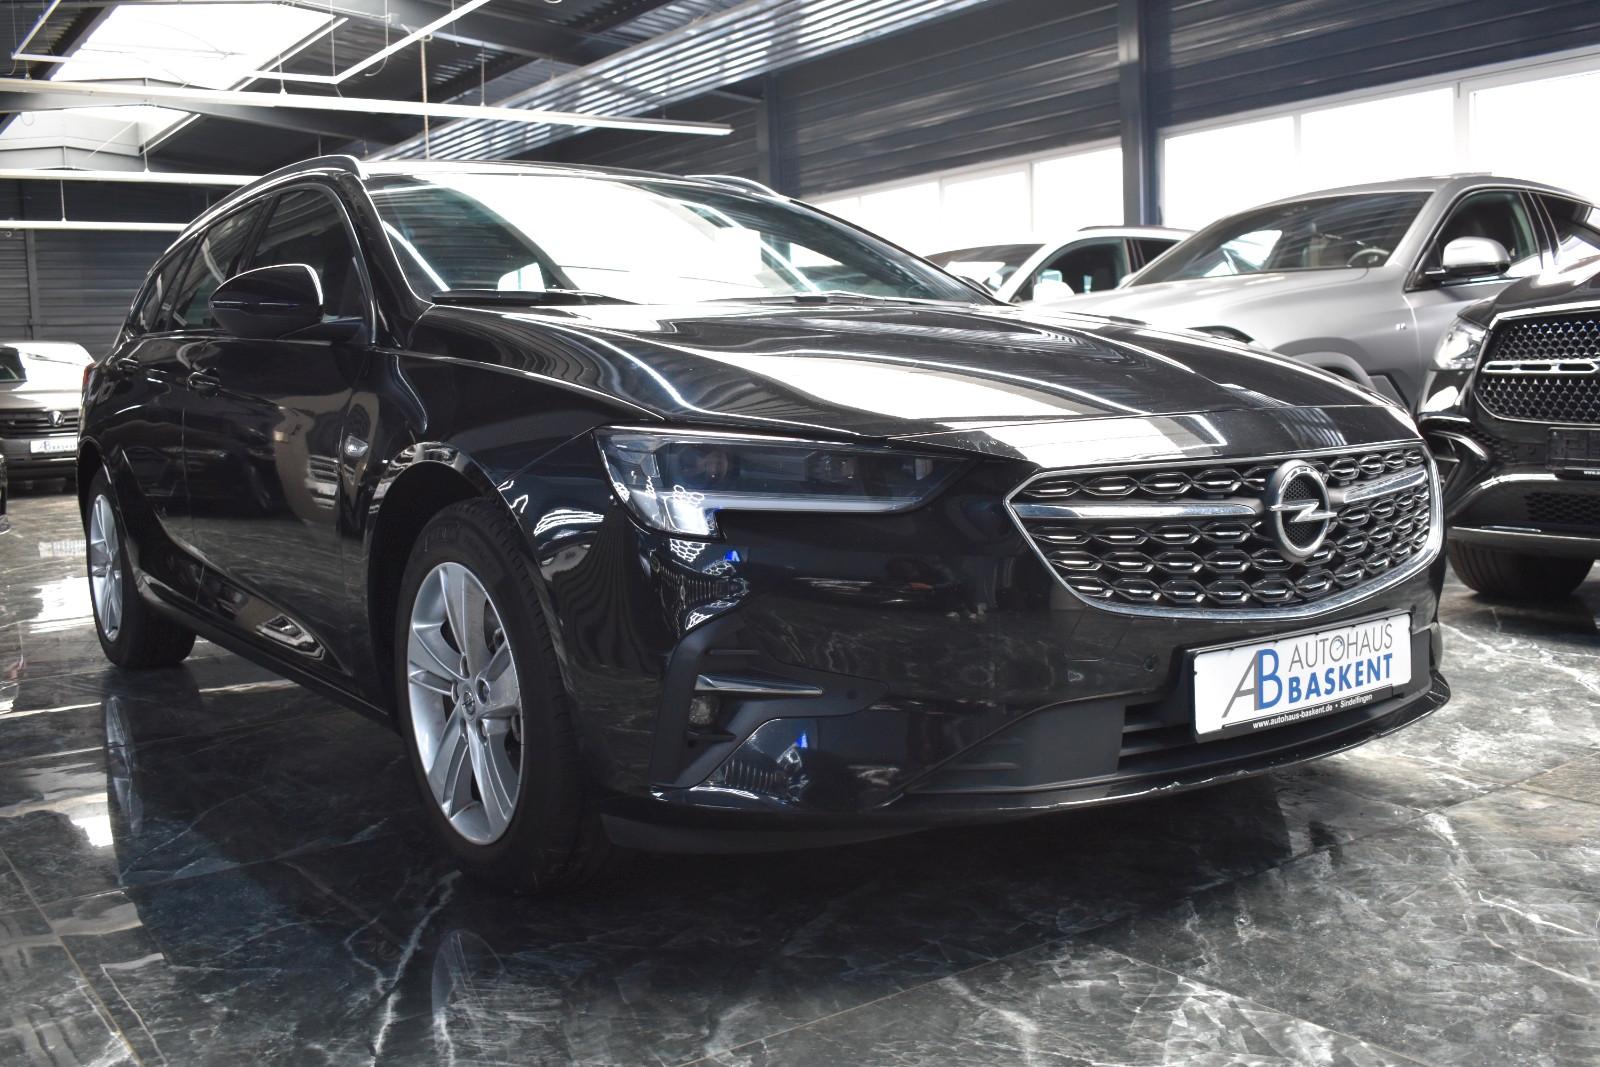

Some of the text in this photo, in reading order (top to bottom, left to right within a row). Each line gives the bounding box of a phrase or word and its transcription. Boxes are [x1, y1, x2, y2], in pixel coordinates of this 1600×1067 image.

[1288, 624, 1392, 672] AUTOHAUS
[1222, 648, 1283, 718] AB
[1288, 653, 1393, 704] BASKENT
[1252, 694, 1373, 728] www.autohaus-baskent.de Sindelfingen
